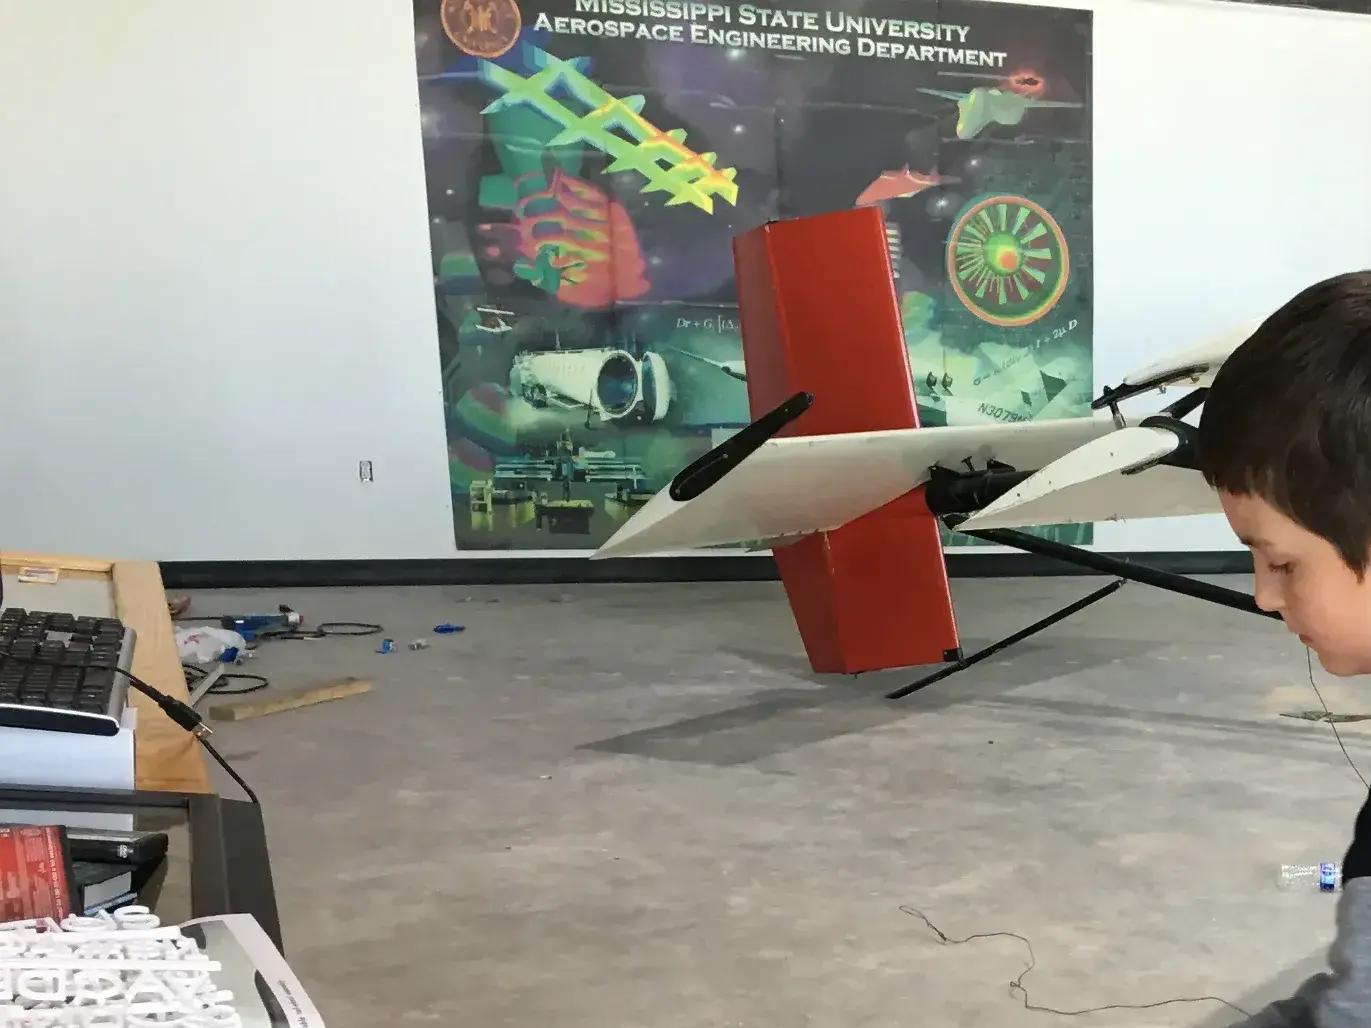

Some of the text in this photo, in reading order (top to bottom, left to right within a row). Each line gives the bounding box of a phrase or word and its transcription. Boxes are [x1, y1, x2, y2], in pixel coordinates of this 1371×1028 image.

[533, 12, 1008, 68] AEROSPACE ENGINEERING DEPARTMENT
[575, 0, 971, 43] MISSISSIPPI STATE UNIVERSITY
